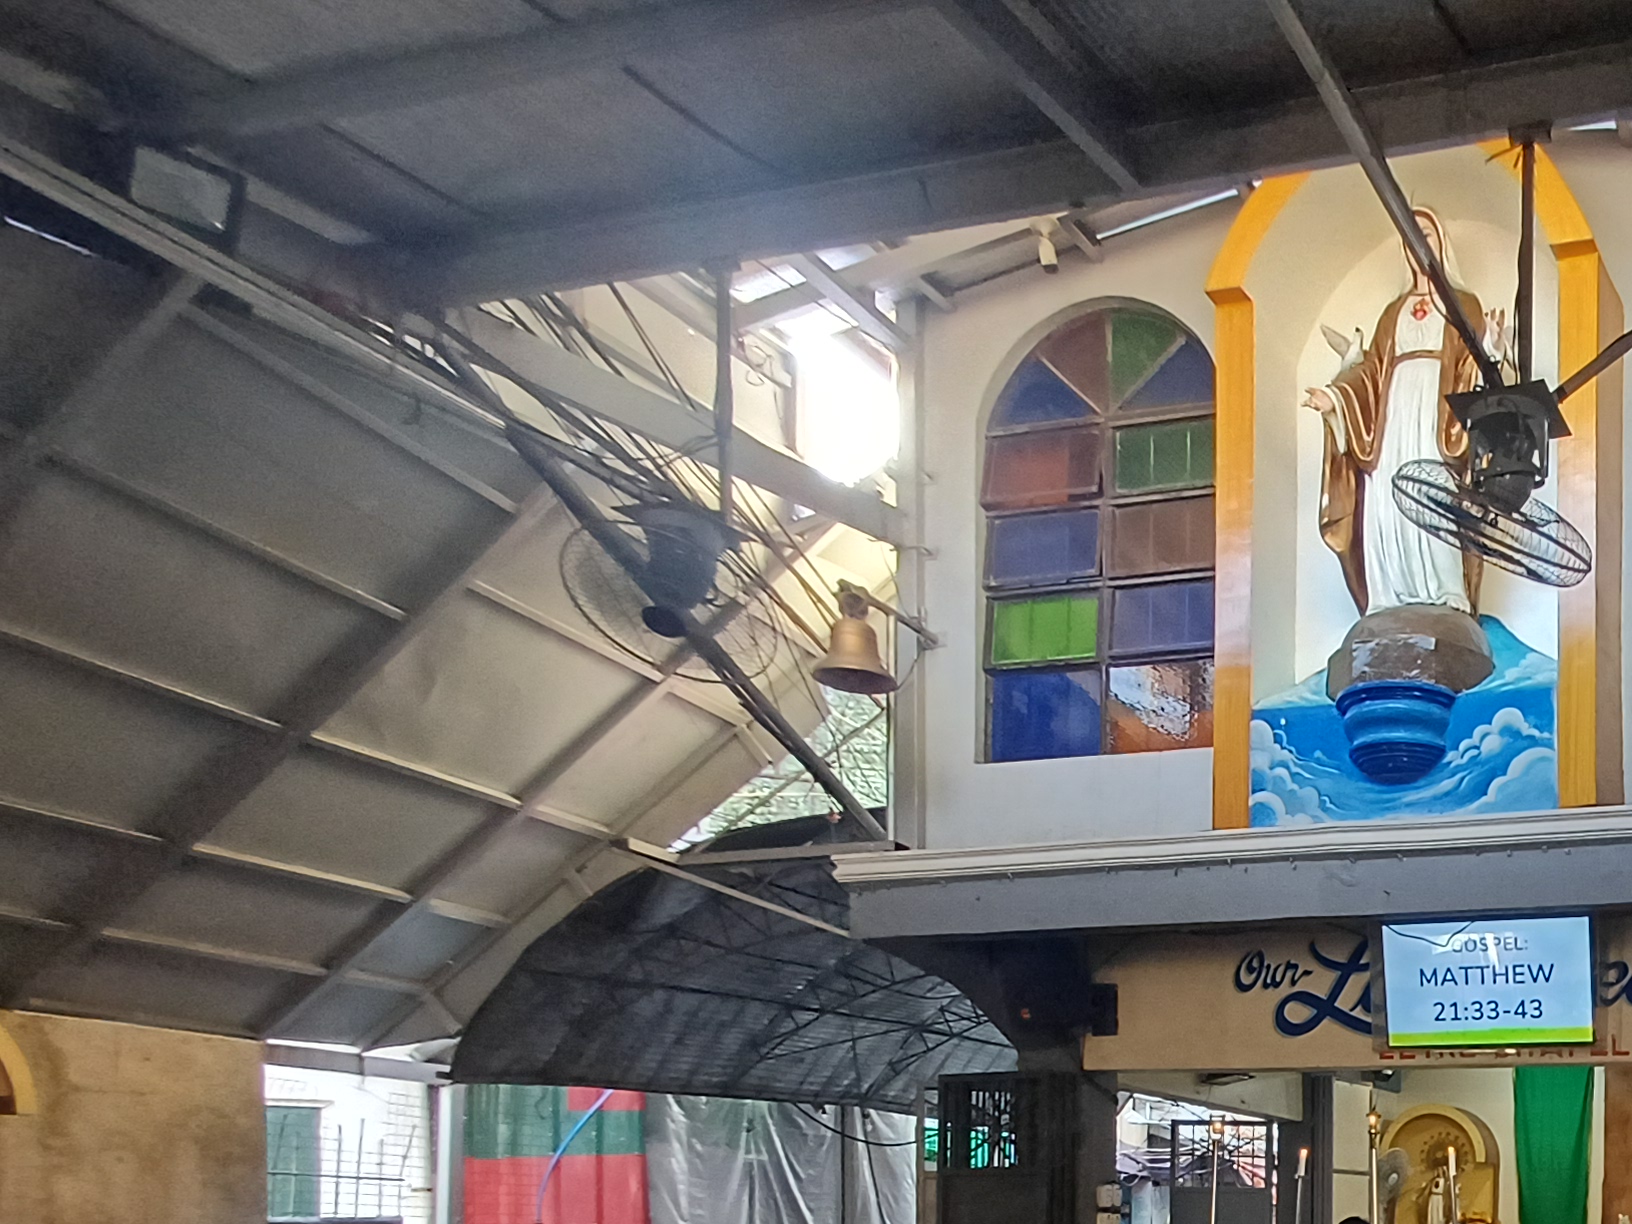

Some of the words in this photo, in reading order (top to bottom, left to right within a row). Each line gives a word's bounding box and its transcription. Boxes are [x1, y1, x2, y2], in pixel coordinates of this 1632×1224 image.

[1451, 936, 1529, 953] GOSPEL:
[1234, 948, 1313, 993] Our
[1418, 962, 1555, 988] MATTHEW
[1433, 998, 1544, 1022] 21:33-43
